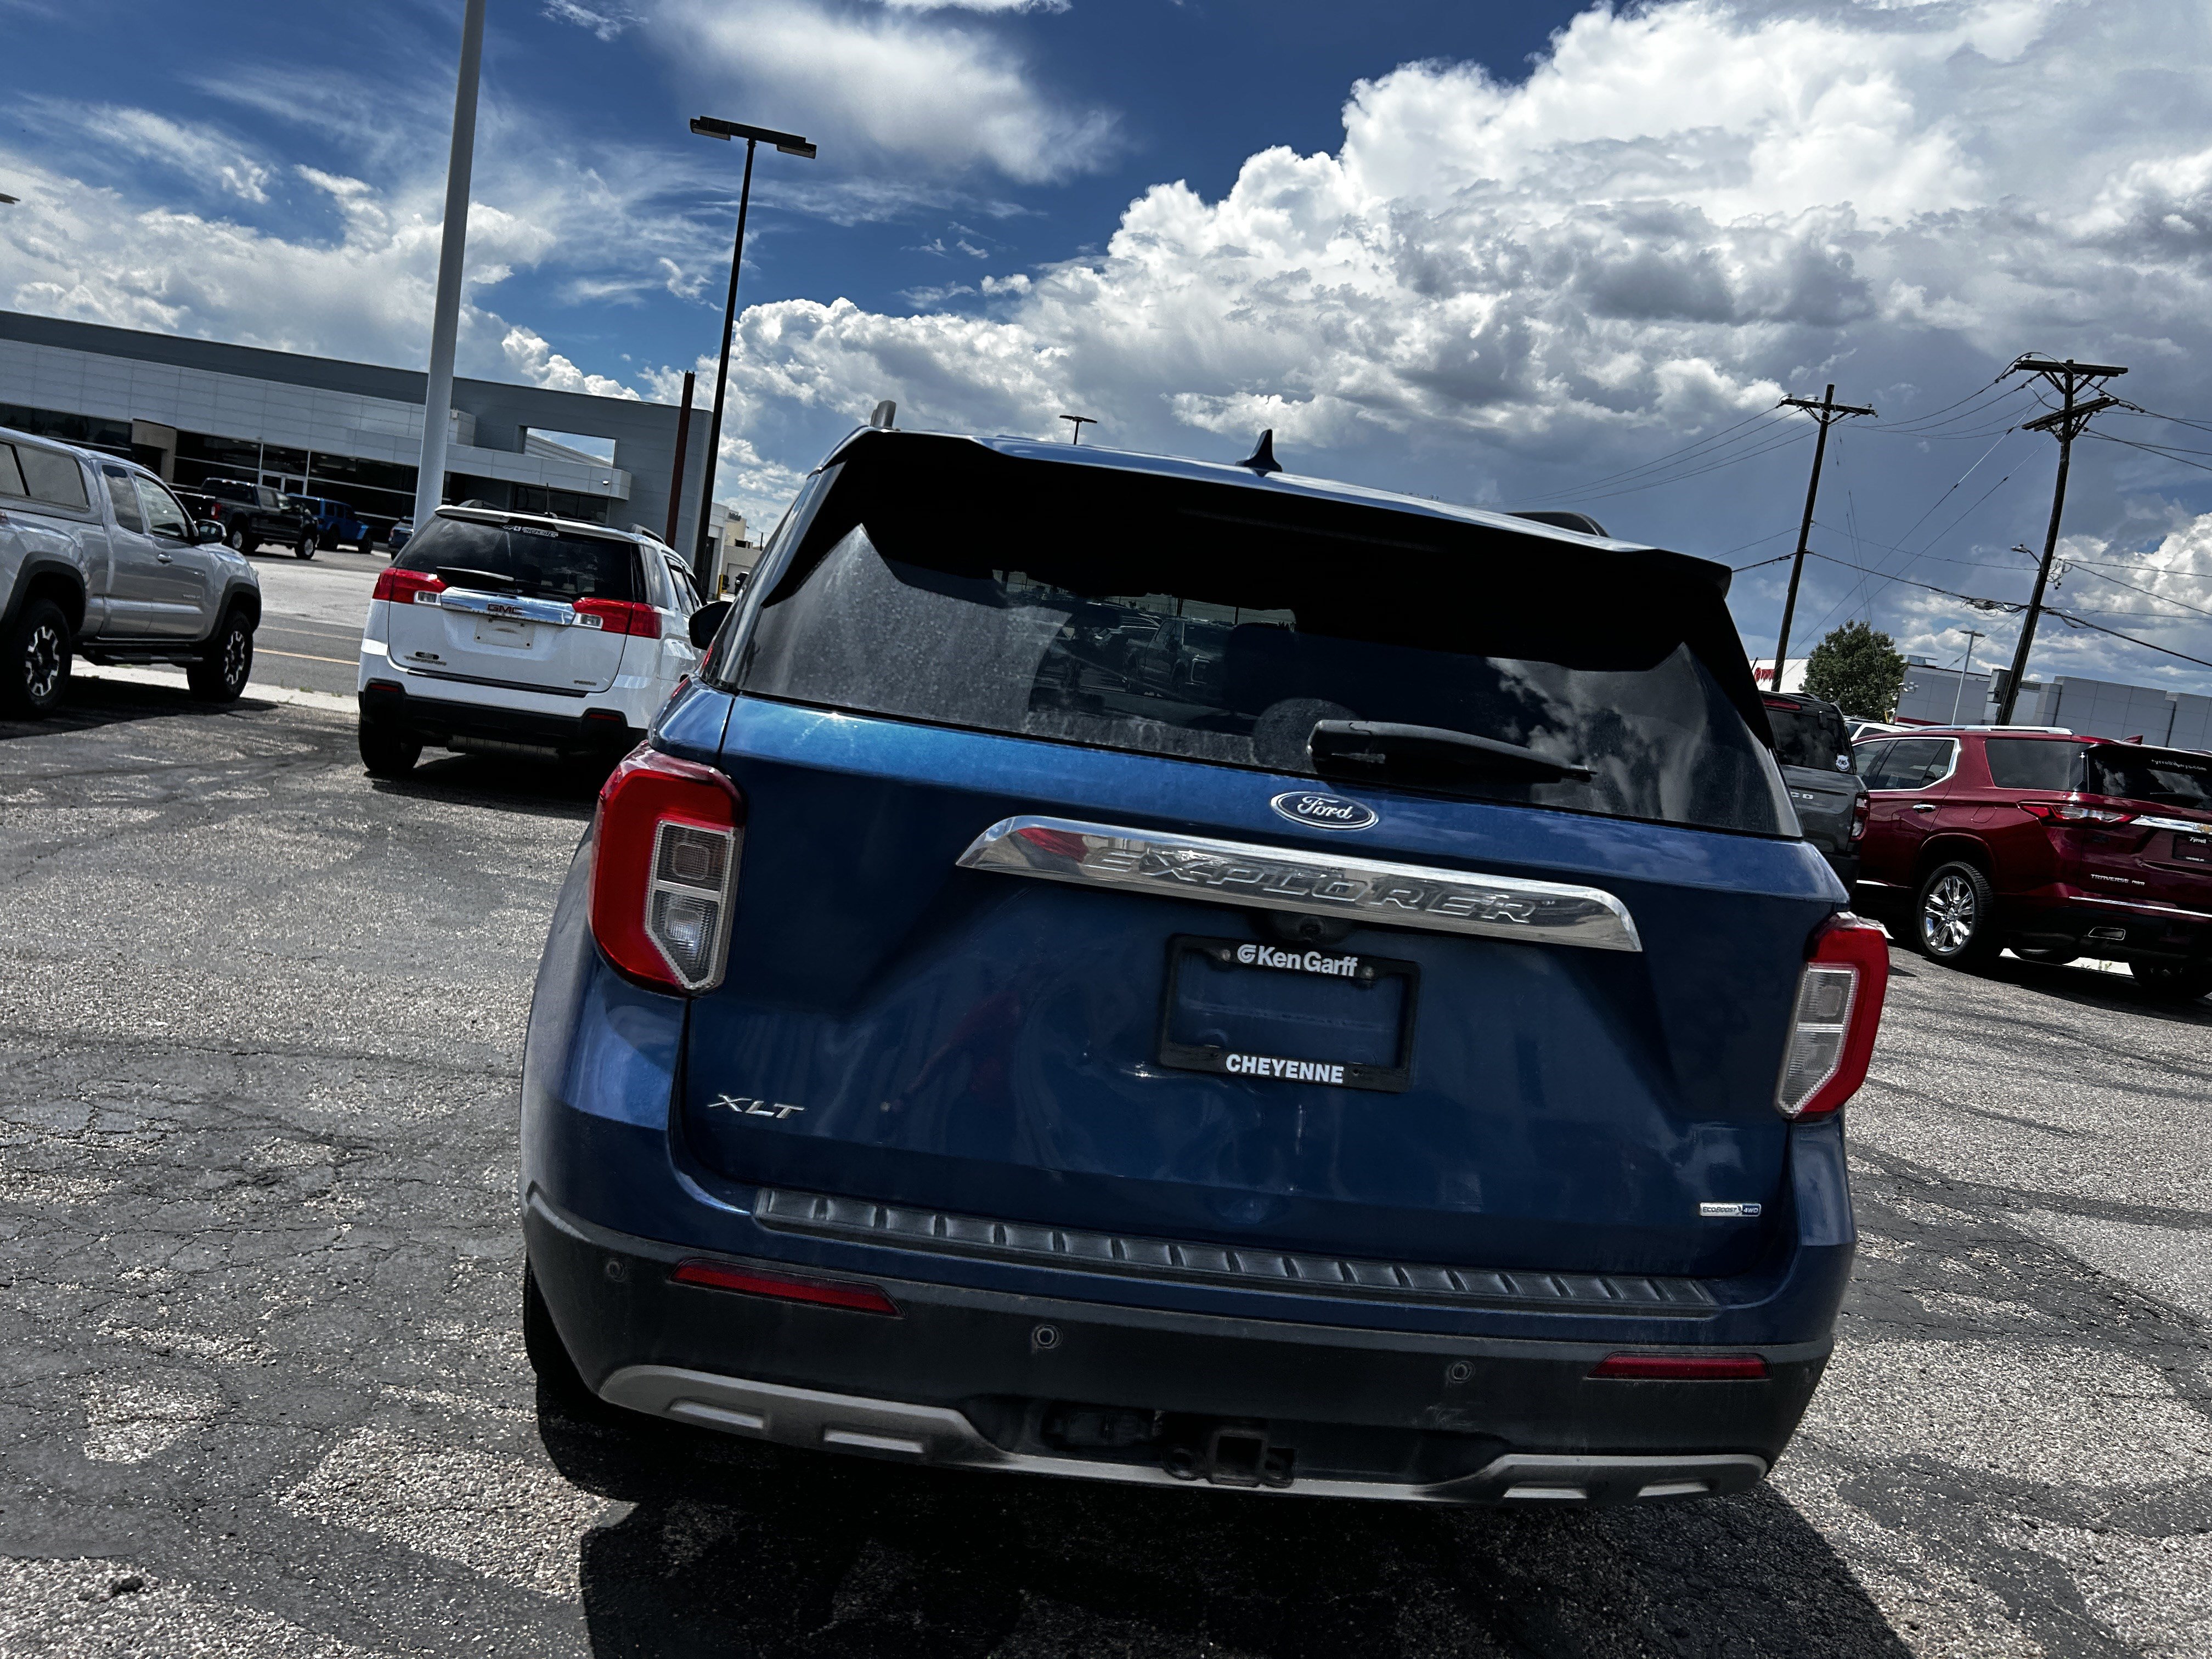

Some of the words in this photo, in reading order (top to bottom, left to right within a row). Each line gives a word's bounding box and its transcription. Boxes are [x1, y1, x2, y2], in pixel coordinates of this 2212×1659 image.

[488, 603, 523, 615] GMC
[1297, 796, 1354, 819] Ford
[1080, 847, 1537, 924] EXPLORER
[1257, 945, 1301, 969] Ken
[1303, 951, 1358, 977] Garff
[1226, 1053, 1344, 1084] CHEYENNE
[707, 1094, 805, 1119] XLT
